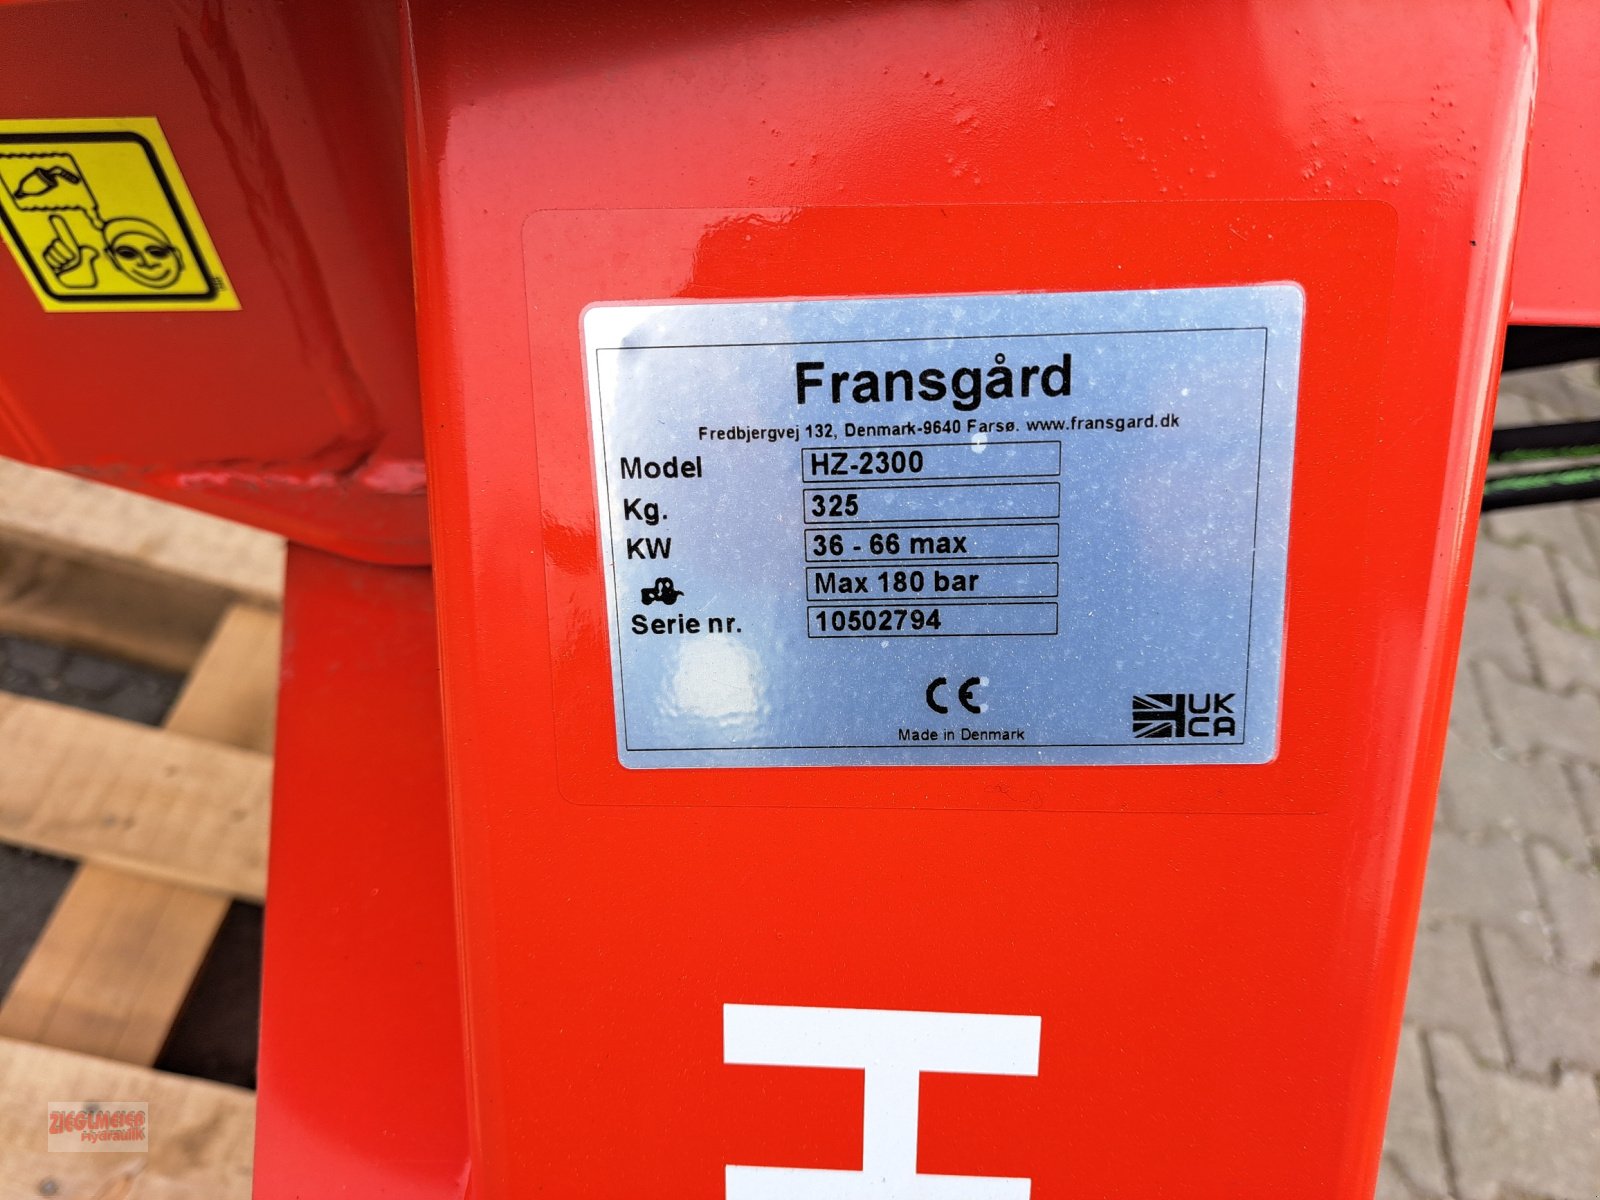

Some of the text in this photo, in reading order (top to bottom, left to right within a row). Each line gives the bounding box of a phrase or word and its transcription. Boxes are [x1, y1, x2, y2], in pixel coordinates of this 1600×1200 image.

[796, 353, 1072, 412] Fransgård
[698, 413, 1180, 443] Fredbjergvej 132, Denmark-9640 Farsø. www.fransgard.dk
[620, 456, 703, 480] Model
[811, 450, 924, 476] HZ-2300
[623, 498, 668, 526] Kg.
[811, 494, 859, 517] 325
[626, 538, 672, 560] KW
[813, 535, 844, 557] 36
[869, 533, 901, 555] 66
[910, 535, 968, 554] max
[815, 571, 980, 594] Max 180 bar
[631, 613, 743, 635] Serie nr.
[816, 609, 942, 632] 10502794
[926, 676, 983, 714] CE
[1187, 693, 1237, 714] UK
[898, 727, 1026, 742] Made in Denmark
[1187, 716, 1237, 737] CA
